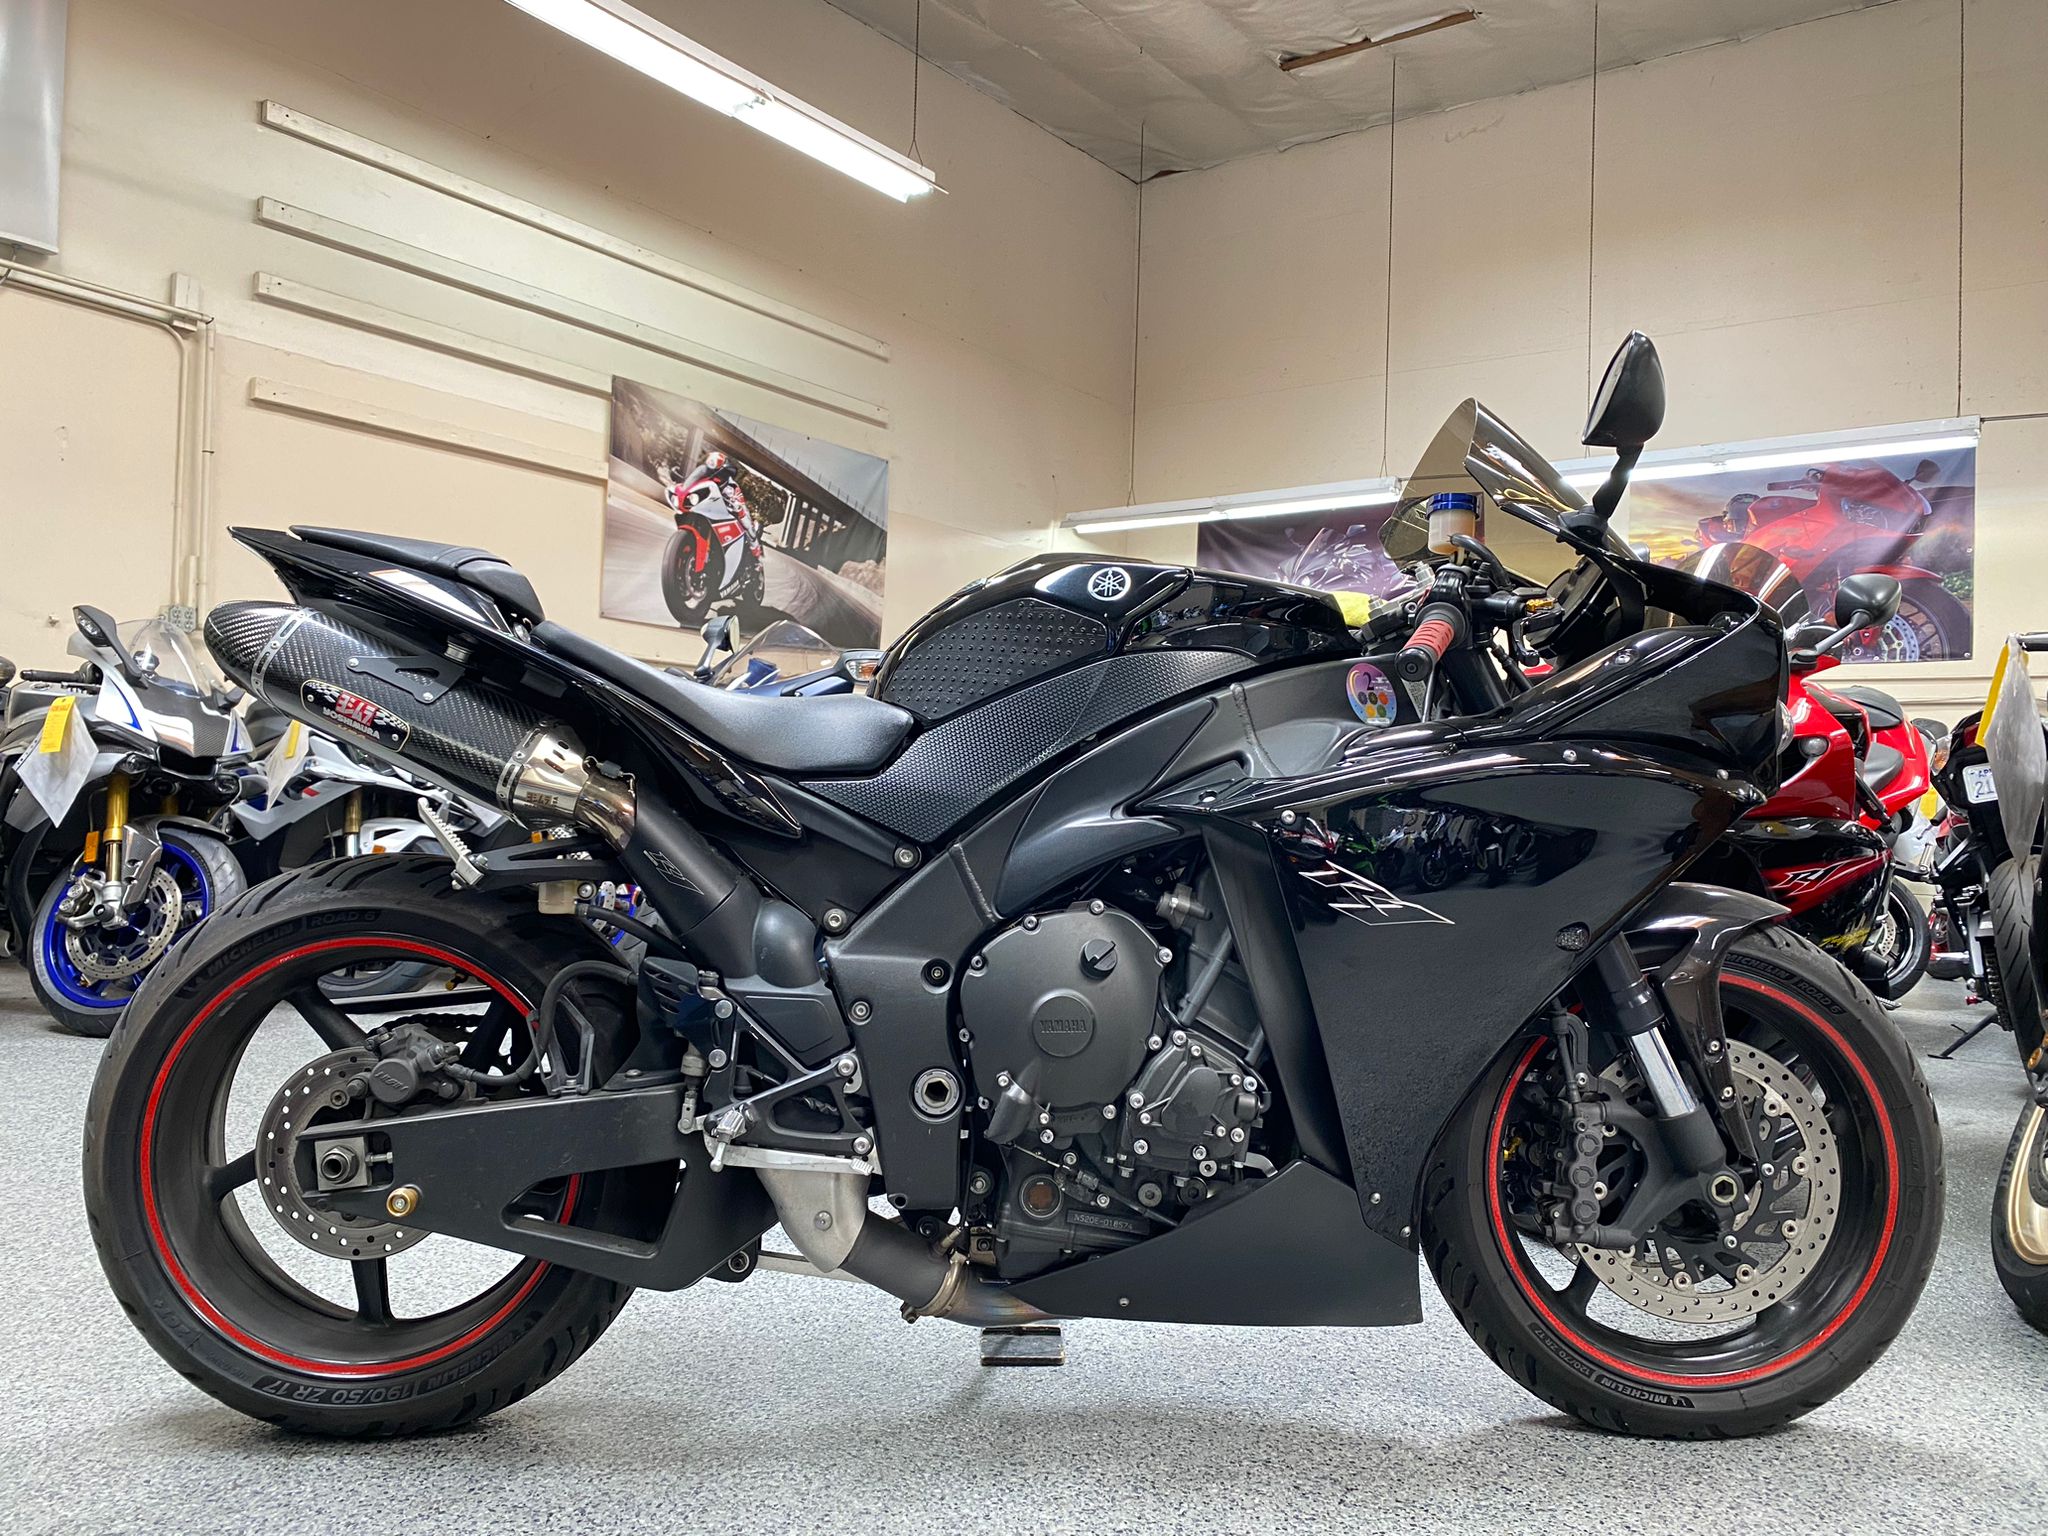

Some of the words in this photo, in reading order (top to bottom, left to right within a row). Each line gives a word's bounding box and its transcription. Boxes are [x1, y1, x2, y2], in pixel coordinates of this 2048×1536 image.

[322, 706, 380, 739] YOSHIMURA
[206, 921, 295, 976] MICHELIN
[310, 911, 361, 928] ROAD
[1724, 952, 1790, 980] MICHELIN
[1798, 980, 1833, 1007] ROAD
[1039, 1019, 1087, 1033] YAMAHA
[1534, 1328, 1546, 1340] 17
[1545, 1338, 1558, 1352] ZR
[1558, 1350, 1592, 1376] 120/70
[261, 1379, 290, 1396] 17
[292, 1386, 328, 1403] ZR
[331, 1381, 412, 1405] 190/50
[1600, 1378, 1671, 1406] MICHELIN
